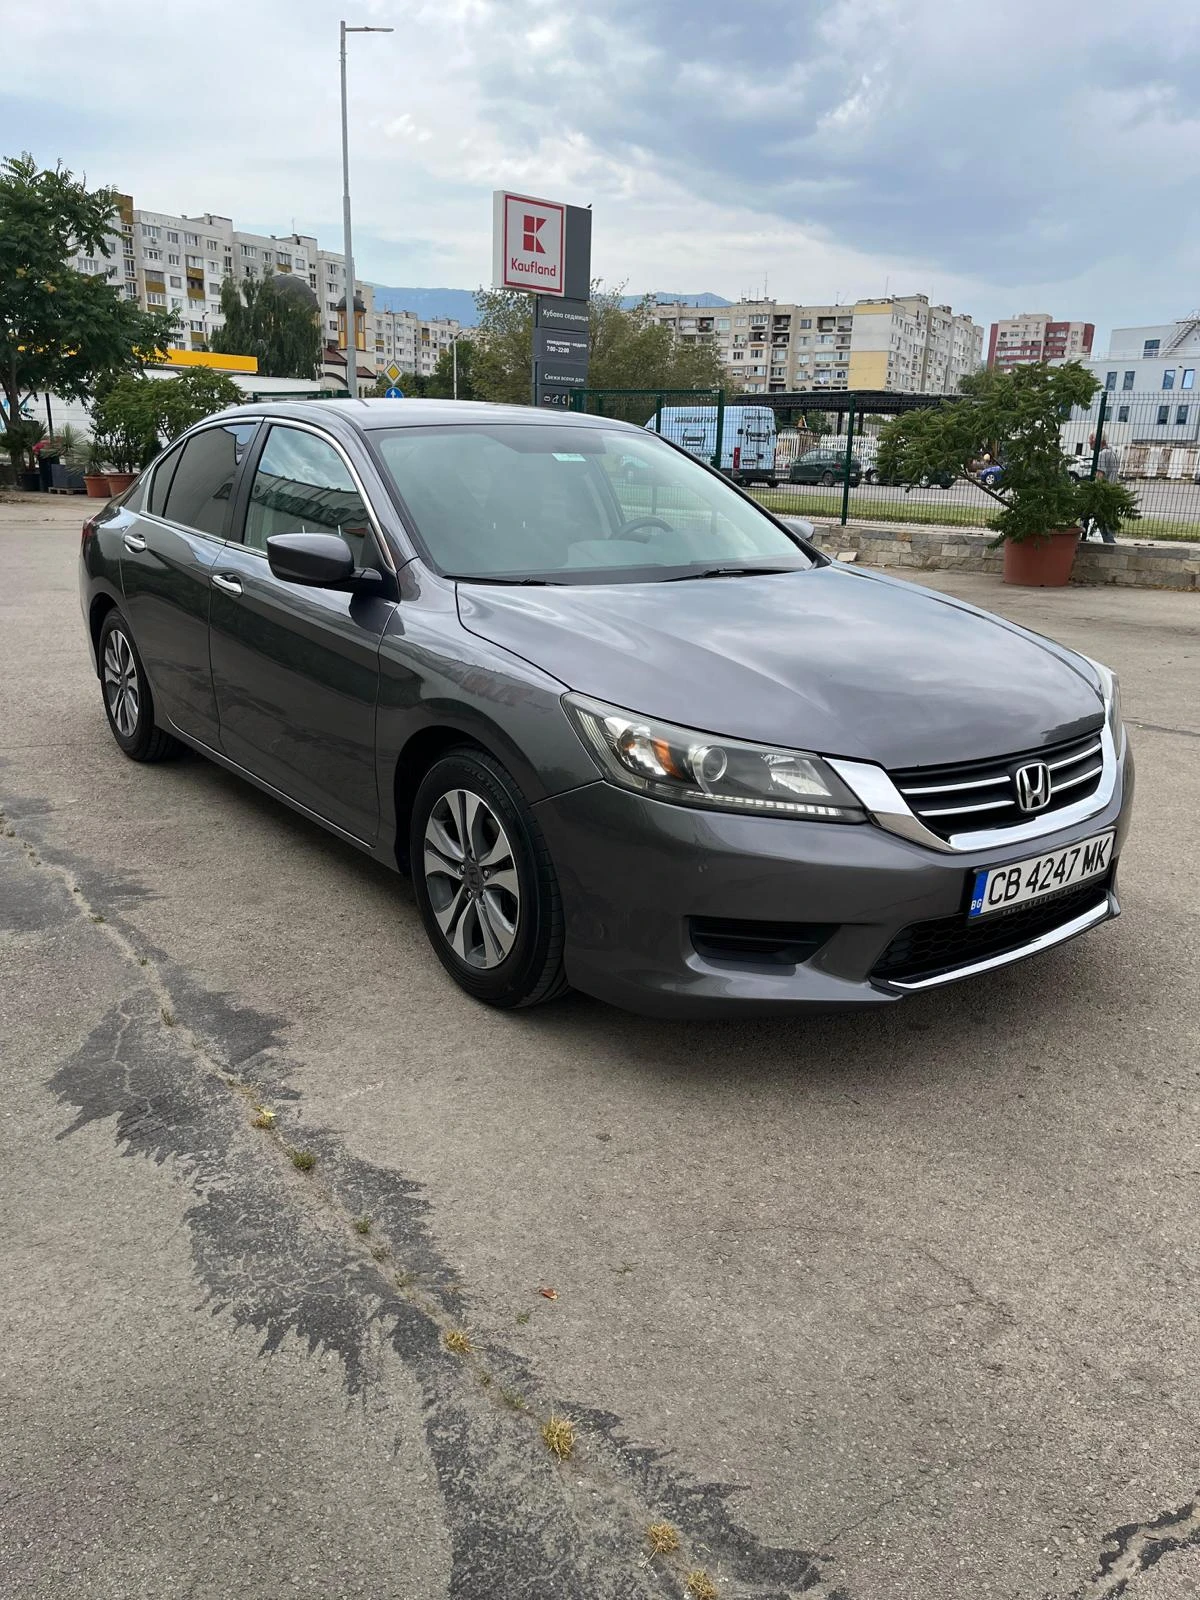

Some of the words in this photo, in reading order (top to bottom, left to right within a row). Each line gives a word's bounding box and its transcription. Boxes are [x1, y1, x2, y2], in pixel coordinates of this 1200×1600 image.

[511, 257, 556, 277] Kaufland
[988, 867, 1022, 906] CB
[1025, 847, 1081, 894] 4247
[1080, 836, 1111, 877] MK
[970, 898, 983, 911] BG
